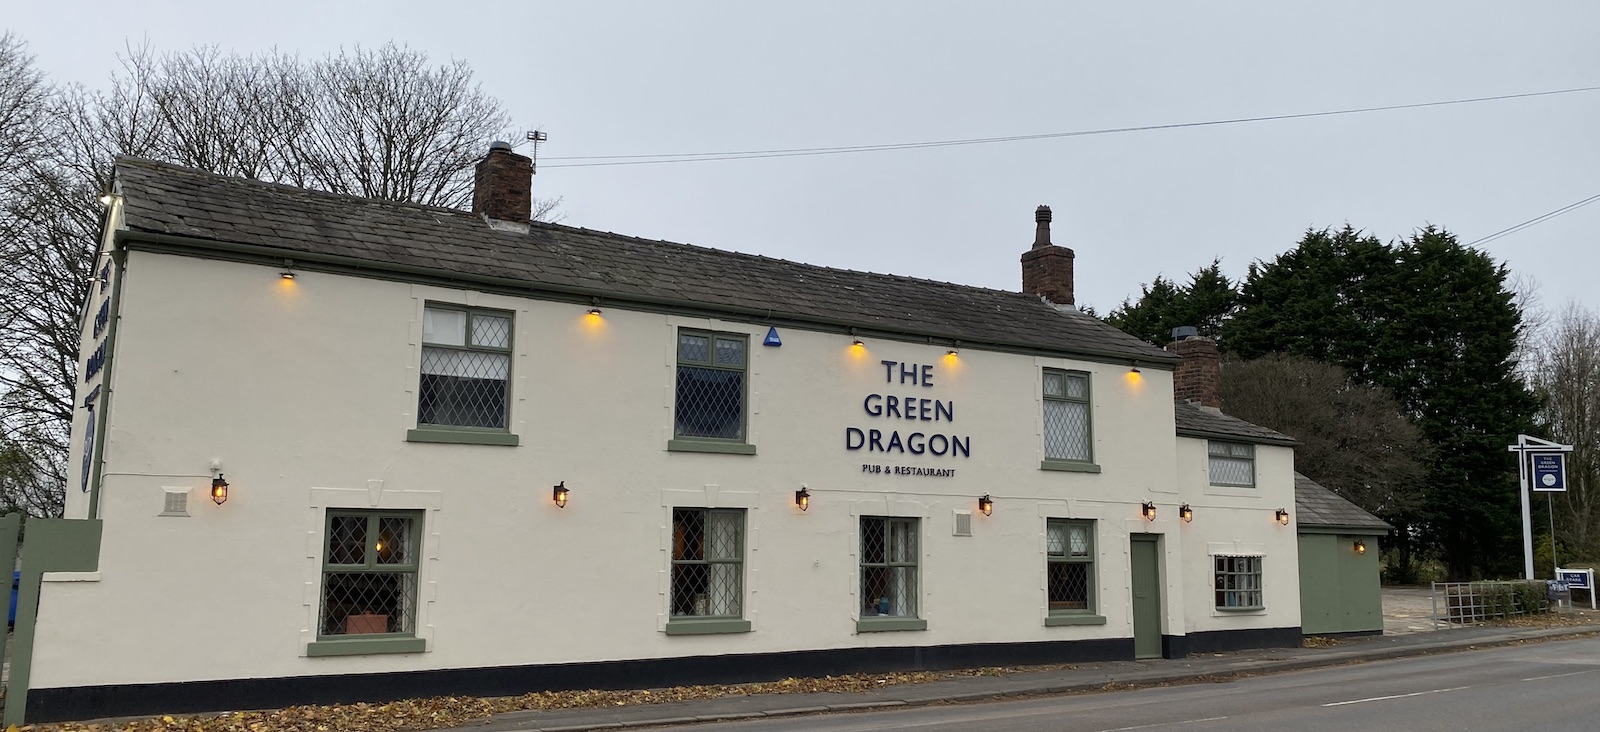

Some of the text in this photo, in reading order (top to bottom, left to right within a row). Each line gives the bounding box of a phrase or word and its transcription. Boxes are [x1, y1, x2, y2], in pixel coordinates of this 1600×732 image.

[881, 360, 934, 387] THE
[864, 393, 953, 422] GREEN
[846, 427, 970, 458] DRAGON
[862, 464, 956, 477] PUB & RESTAURANT
